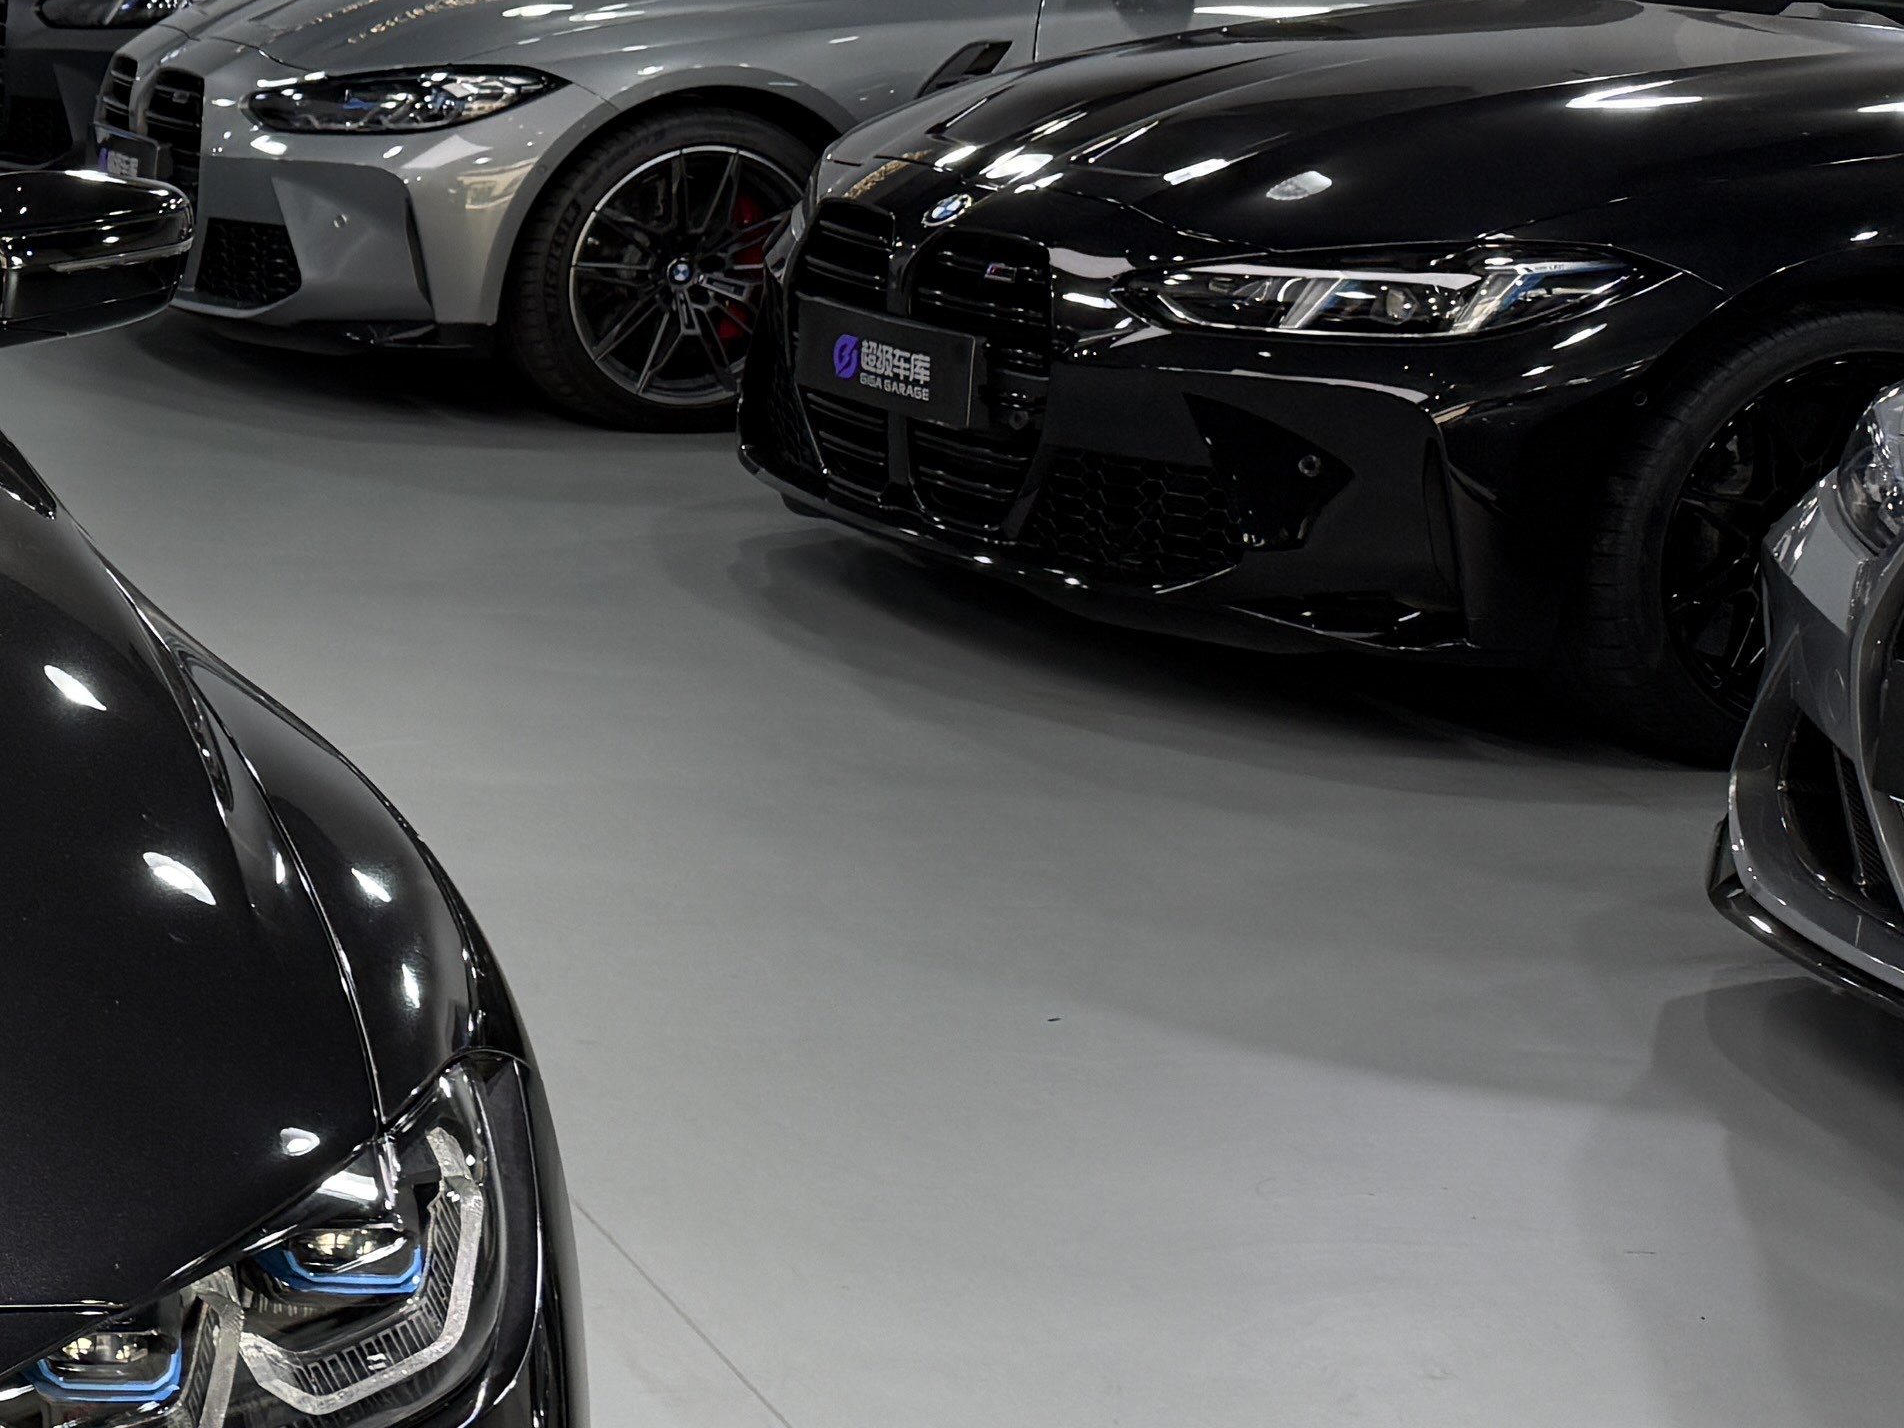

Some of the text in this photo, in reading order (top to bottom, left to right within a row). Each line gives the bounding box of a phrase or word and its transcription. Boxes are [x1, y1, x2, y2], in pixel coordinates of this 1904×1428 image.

[860, 339, 931, 384] 超级车库
[883, 379, 930, 402] GARAGE
